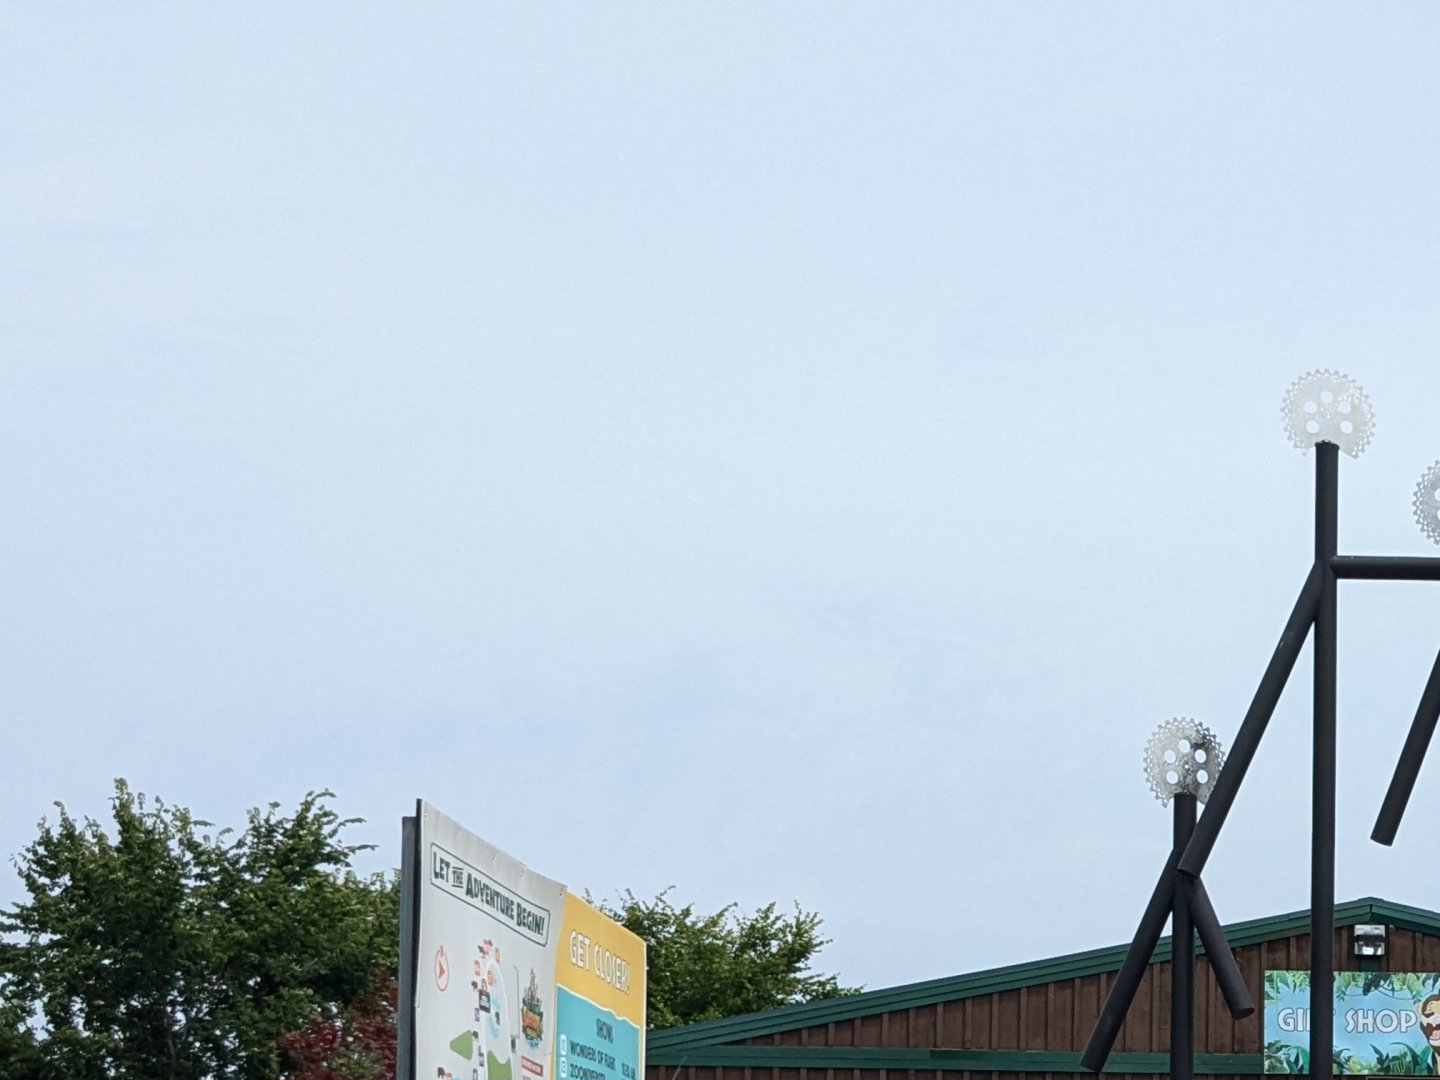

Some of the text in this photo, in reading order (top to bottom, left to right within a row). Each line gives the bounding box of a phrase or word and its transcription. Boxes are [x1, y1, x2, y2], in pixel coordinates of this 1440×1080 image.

[433, 851, 450, 883] LET
[465, 872, 515, 921] ADVENTURE
[516, 902, 546, 936] BEGIN!
[569, 929, 631, 996] GET CLOSER!
[1344, 1007, 1417, 1033] SHOP
